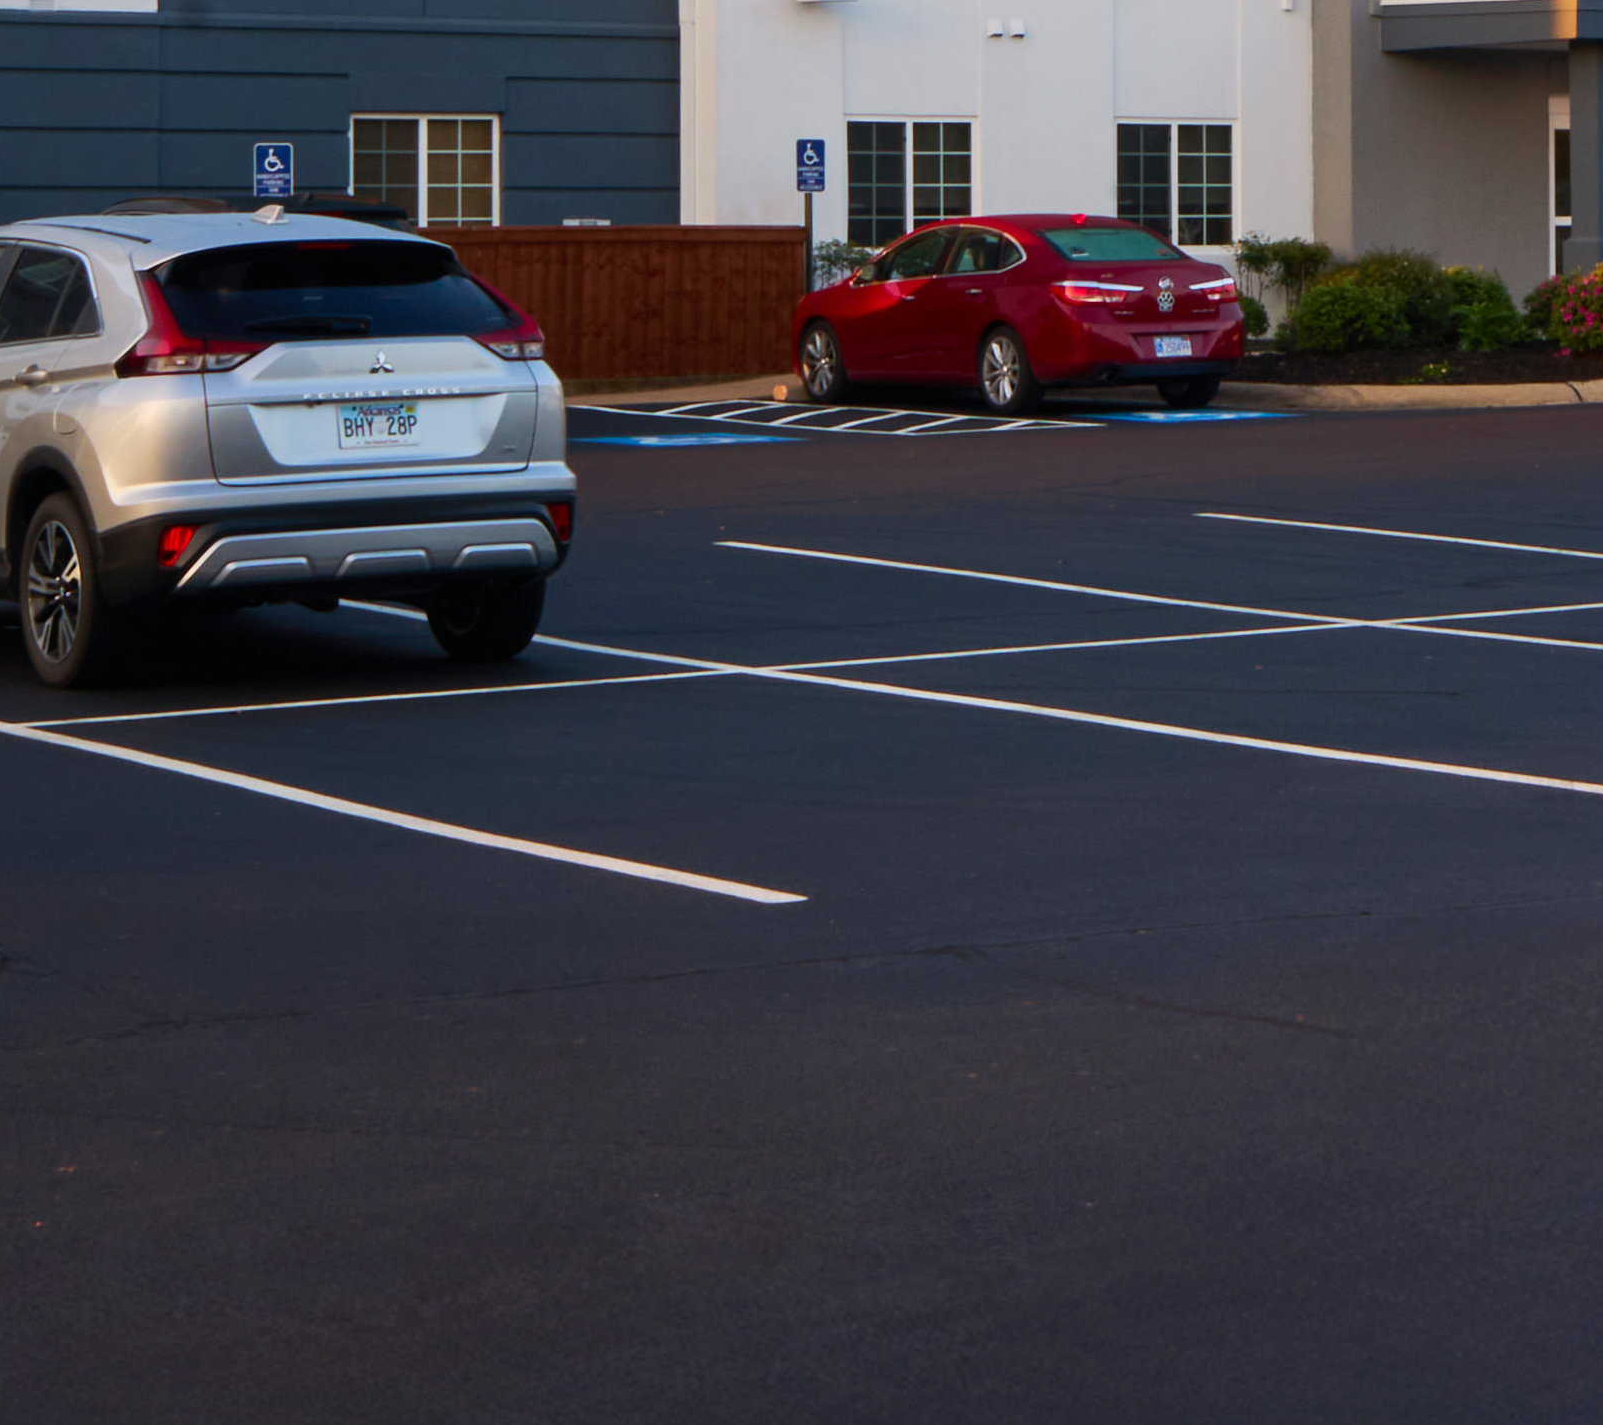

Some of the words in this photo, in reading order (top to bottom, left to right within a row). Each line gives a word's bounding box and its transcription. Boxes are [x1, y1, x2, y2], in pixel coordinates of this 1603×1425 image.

[303, 389, 390, 400] ECLIPSE
[402, 387, 461, 396] CROSS
[356, 405, 401, 417] Arkansas
[343, 417, 374, 438] BHY
[386, 415, 417, 436] 28P
